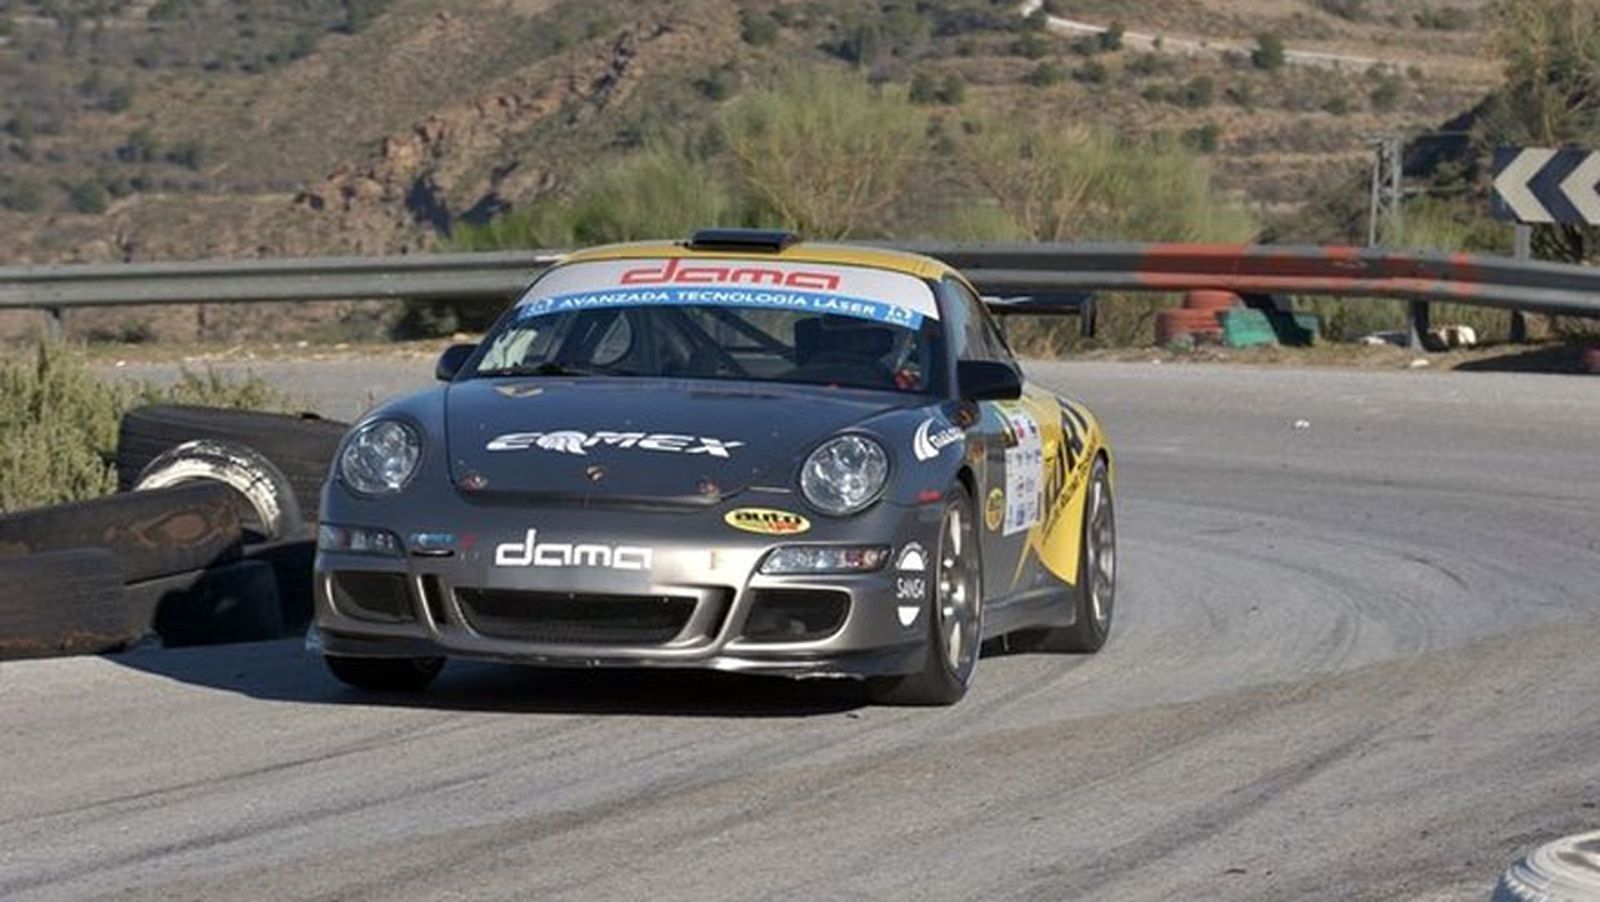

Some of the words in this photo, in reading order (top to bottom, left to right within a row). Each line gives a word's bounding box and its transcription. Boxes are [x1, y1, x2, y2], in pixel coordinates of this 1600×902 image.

[620, 258, 841, 291] dama
[559, 290, 669, 309] AVANZADA
[495, 528, 652, 570] dama
